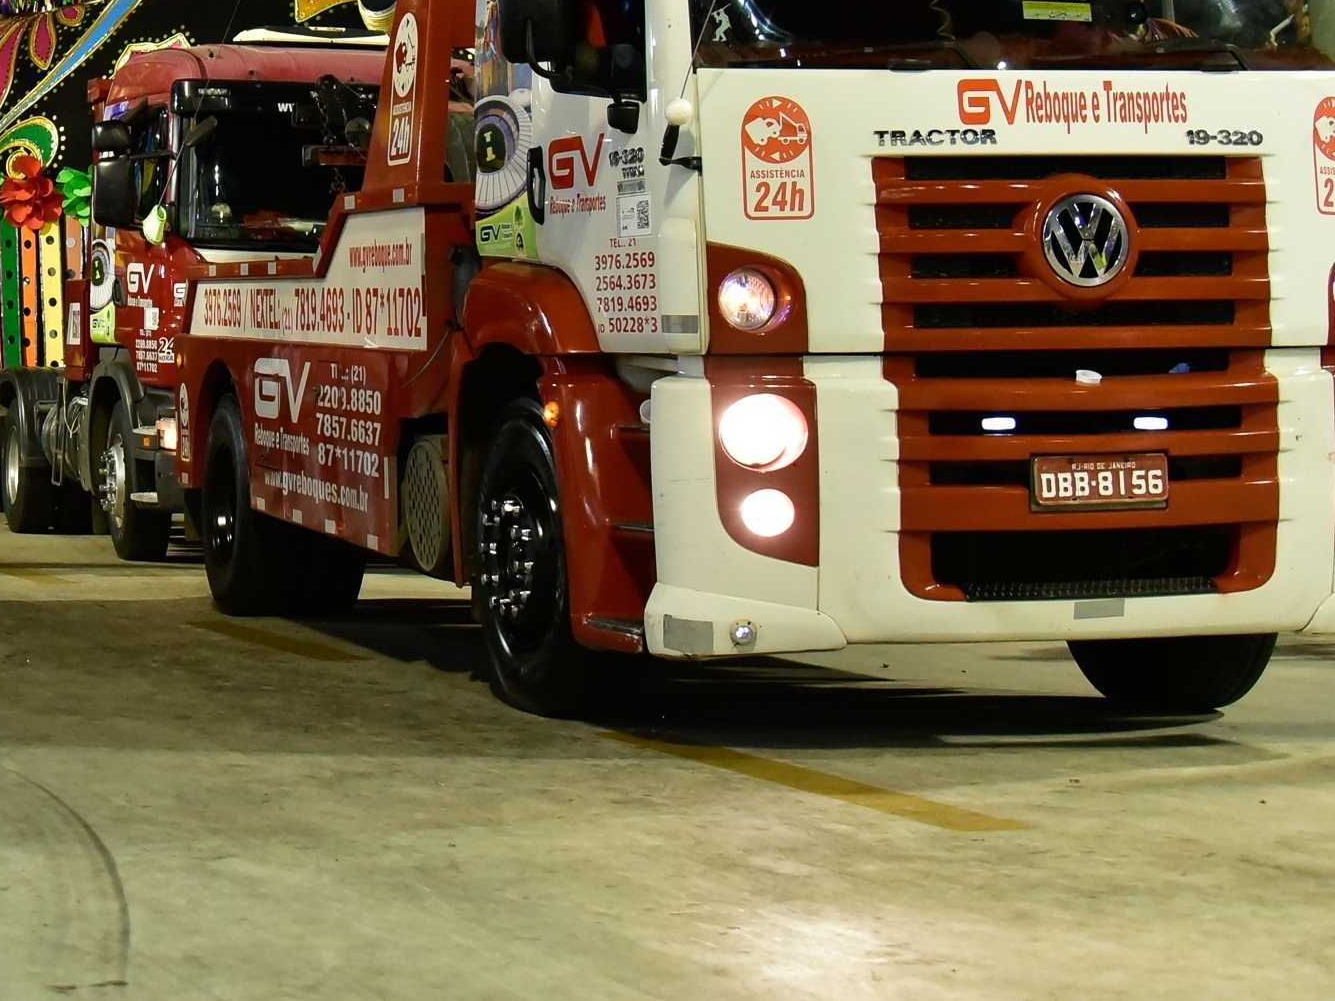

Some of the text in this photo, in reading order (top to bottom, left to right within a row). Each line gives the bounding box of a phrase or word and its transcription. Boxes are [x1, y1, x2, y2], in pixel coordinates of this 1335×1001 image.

[957, 79, 1188, 134] GV Reboque e Transportes
[391, 116, 410, 156] 24h
[874, 129, 998, 147] TRACTOR
[1185, 129, 1264, 147] 19-320
[548, 133, 605, 190] GV
[750, 168, 805, 179] ASSISTÊNCIA
[576, 192, 606, 217] Transportes
[754, 181, 805, 213] 24h
[480, 224, 501, 242] GV
[594, 251, 655, 270] 3976.2569
[126, 262, 155, 294] GV
[596, 273, 656, 291] 2564.3673
[204, 288, 241, 327] 3976.2569
[250, 288, 280, 330] NEXTEL:
[282, 307, 293, 336] (21)
[295, 287, 345, 333] 7819.4693
[352, 288, 362, 334] ID
[597, 295, 657, 313] 7819.4693
[351, 365, 366, 386] (21)
[254, 357, 311, 424] GV
[254, 422, 309, 458] Reboque e Transportes
[316, 412, 381, 446] 7857.6637
[1097, 462, 1105, 470] DE
[1108, 461, 1136, 469] JANEIRO
[264, 470, 368, 513] www.gvreboques.com.br
